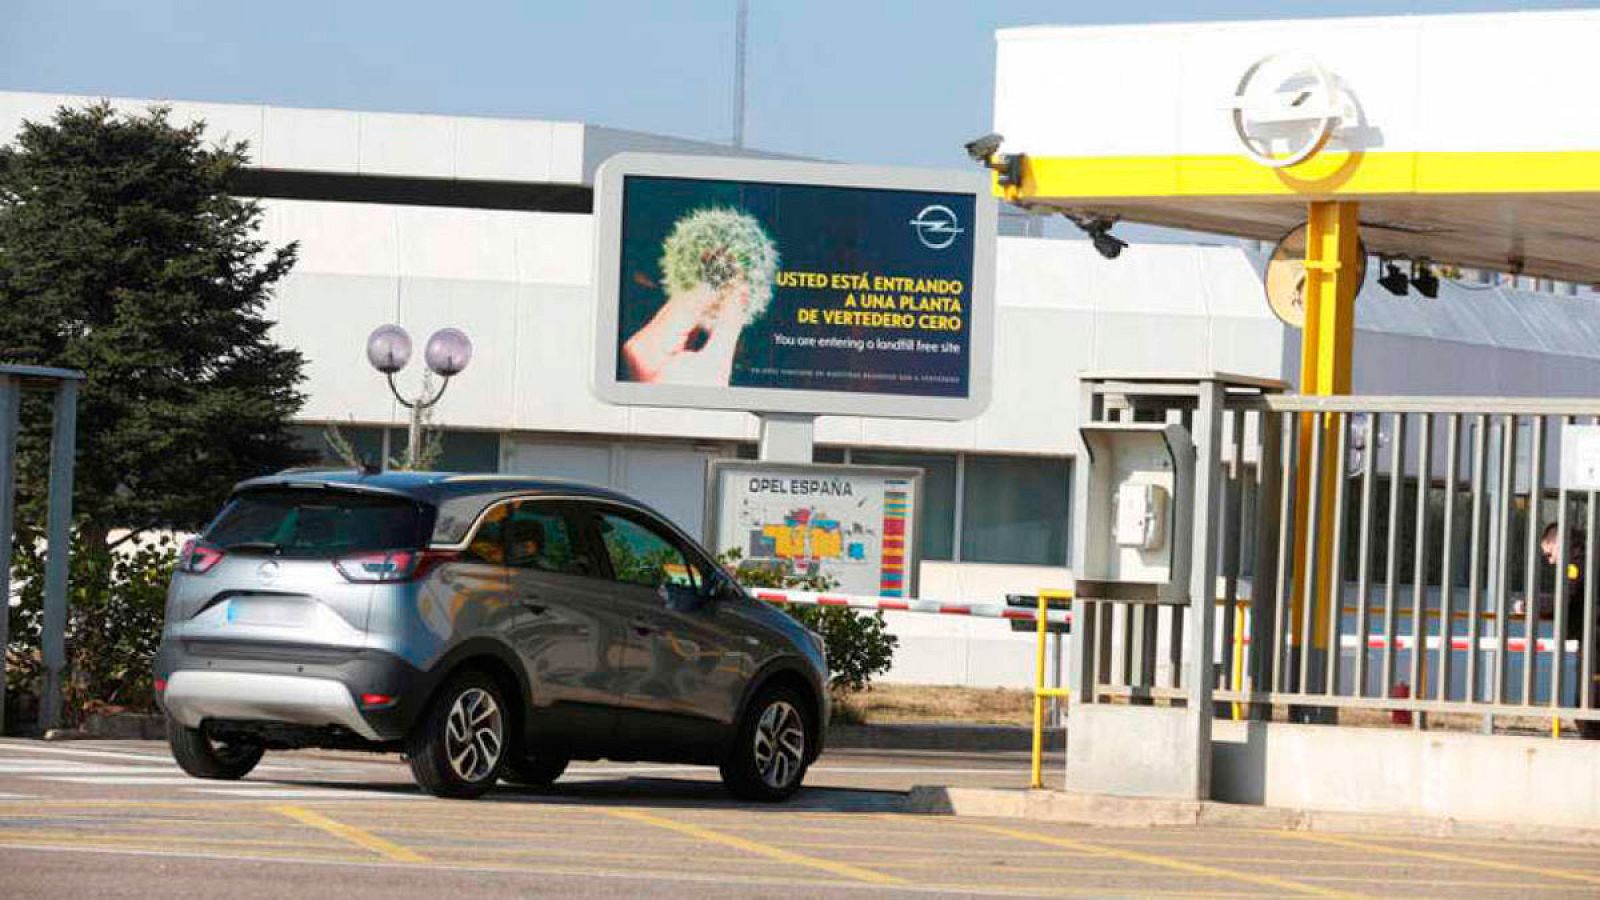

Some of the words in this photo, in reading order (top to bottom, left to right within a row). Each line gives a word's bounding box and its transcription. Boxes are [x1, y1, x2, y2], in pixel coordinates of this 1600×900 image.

[776, 271, 829, 288] USTED
[831, 271, 869, 290] ESTÁ
[874, 275, 963, 294] ENTRANDO
[845, 292, 857, 308] A
[860, 293, 896, 310] UNA
[899, 295, 962, 313] PLANTA
[797, 307, 819, 325] DE
[823, 309, 915, 329] VERTEDERO
[918, 314, 963, 331] CERO
[774, 332, 795, 346] You
[798, 336, 817, 348] are
[818, 337, 864, 354] entering
[866, 340, 875, 349] a
[876, 338, 915, 352] landfill
[915, 340, 940, 353] free
[941, 341, 961, 354] site
[749, 478, 787, 493] OPEL
[791, 477, 853, 497] ESPAÑA
